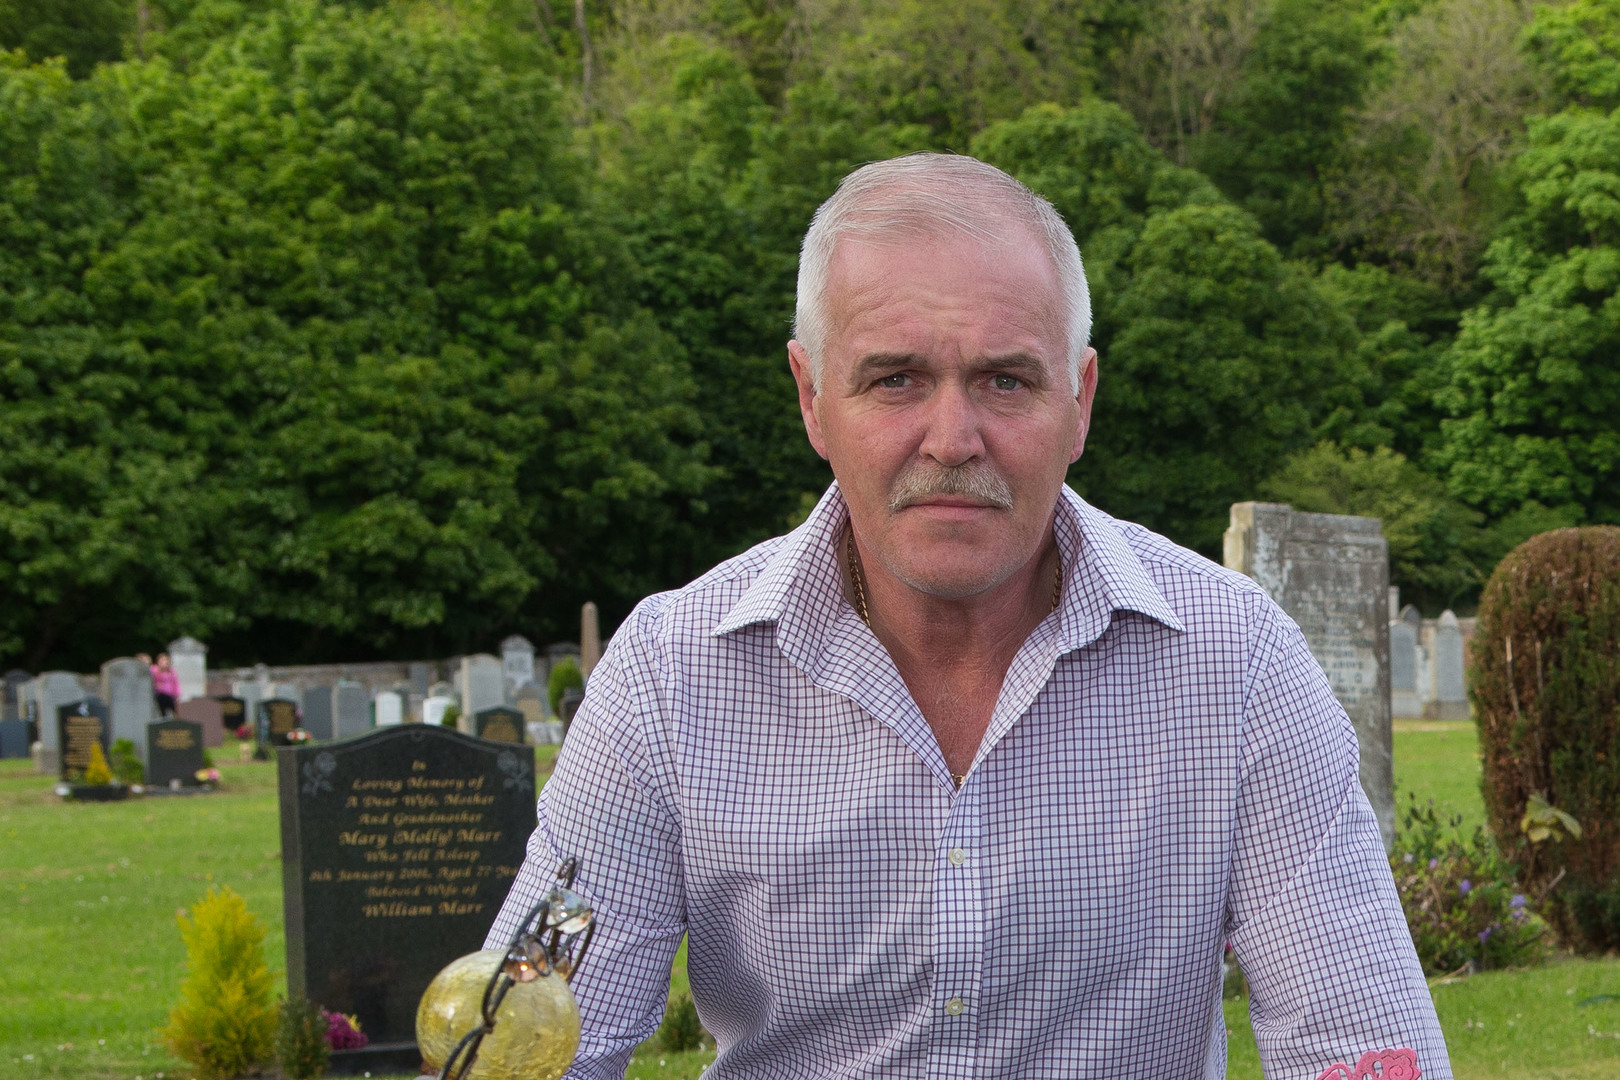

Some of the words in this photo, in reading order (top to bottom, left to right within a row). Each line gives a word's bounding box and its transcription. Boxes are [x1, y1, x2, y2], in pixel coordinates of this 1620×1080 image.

[352, 779, 402, 792] Loving
[408, 777, 464, 790] Memory
[468, 775, 484, 789] of
[362, 796, 398, 808] Dear
[444, 794, 496, 806] Mother
[358, 812, 388, 825] And
[393, 811, 483, 826] Grandmother
[339, 830, 387, 848] Mary
[364, 850, 398, 862] Who
[362, 902, 433, 917] William
